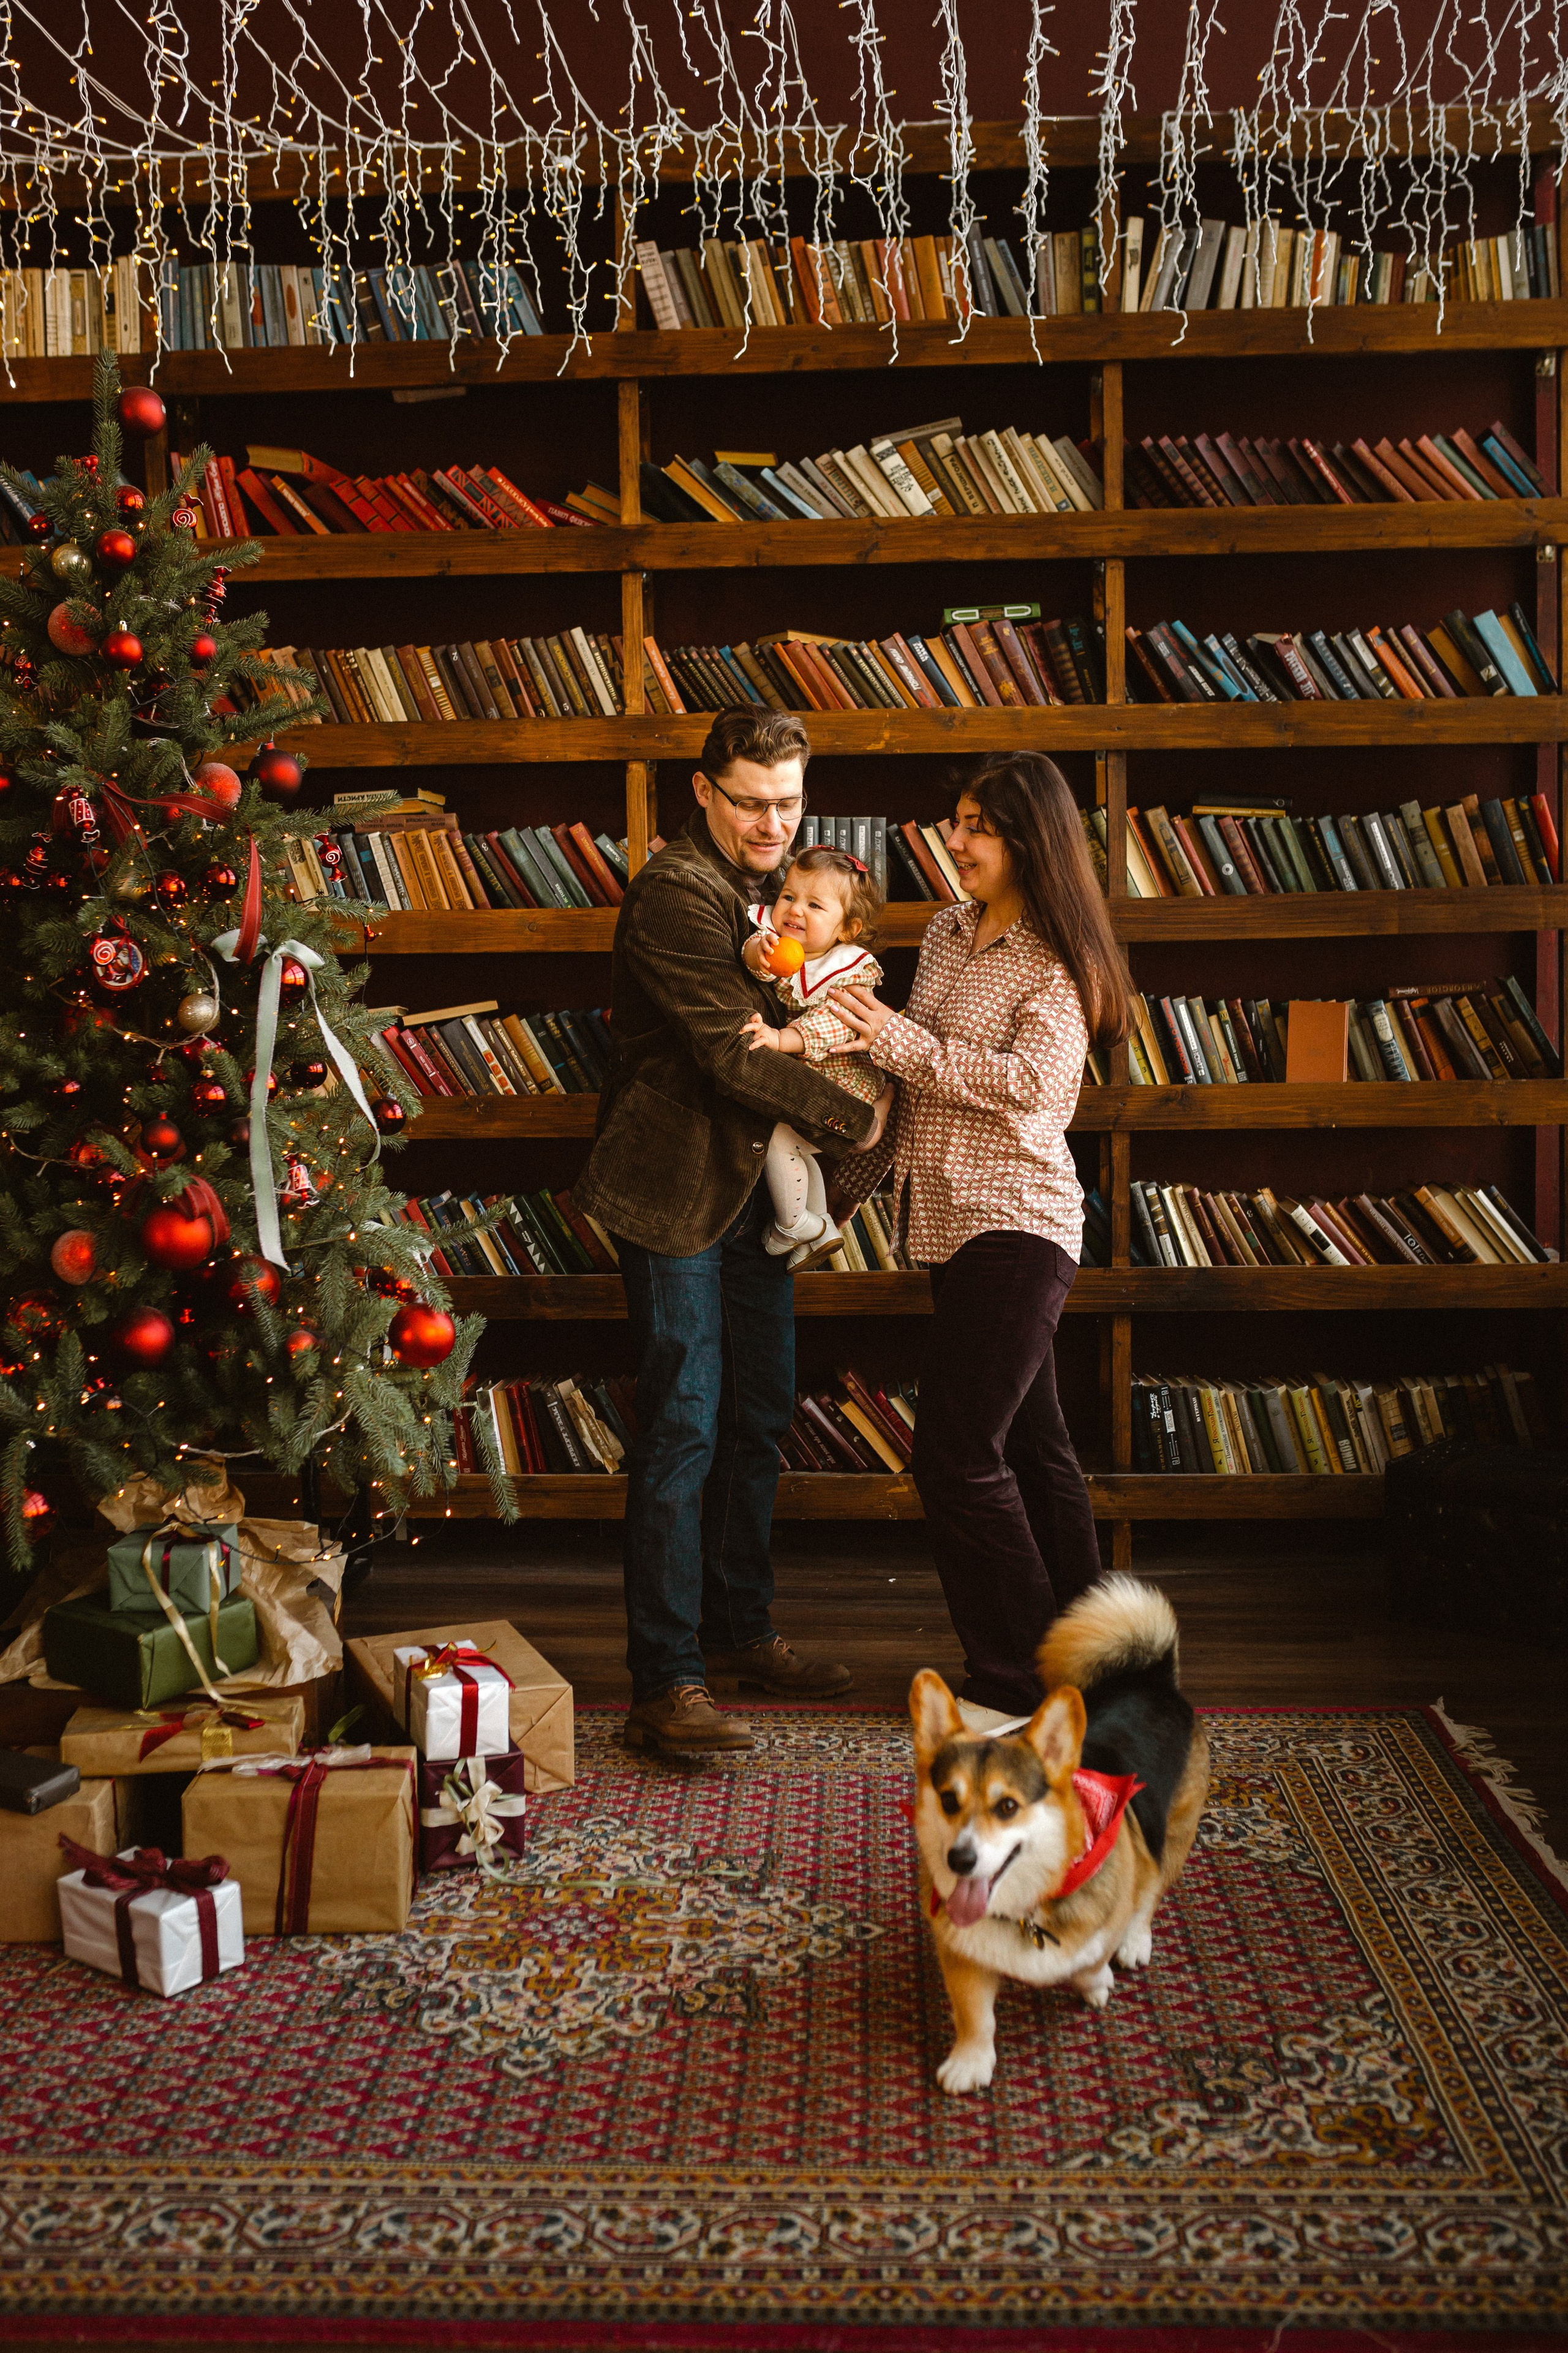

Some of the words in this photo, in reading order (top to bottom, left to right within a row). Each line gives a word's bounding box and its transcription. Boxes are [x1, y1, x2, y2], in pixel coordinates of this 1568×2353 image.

[947, 457, 976, 500] ВЕРШИГОРА
[547, 506, 569, 519] ПАВЕЛ
[552, 644, 572, 678] СИМОНОВ
[480, 842, 489, 852] 3
[470, 844, 494, 878] ГЕРЦЕН
[554, 883, 569, 903] ИСТОРИЯ
[496, 1027, 513, 1050] Альманах
[1223, 1024, 1238, 1054] КАПИТАЛЬНЫЙ
[1232, 1053, 1242, 1070] РЕМОНТ
[1172, 1036, 1191, 1075] РАССКАЗЫ
[860, 1206, 880, 1239] АНАТОЛИЙ
[1181, 1205, 1188, 1214] НА
[1245, 1209, 1254, 1218] 3
[1185, 1214, 1196, 1232] ПРАВО
[550, 1405, 566, 1432] УЭЛЛС
[1191, 1397, 1200, 1416] ГЕРМАН
[1208, 1416, 1219, 1444] Ярослав
[1216, 1409, 1225, 1432] книжные
[1301, 1416, 1314, 1444] Ярослав
[560, 1432, 581, 1468] ГЕРБЕРТ
[812, 1435, 822, 1445] при
[1156, 1433, 1165, 1463] ИЛЬИНА
[1221, 1433, 1232, 1459] Памятные
